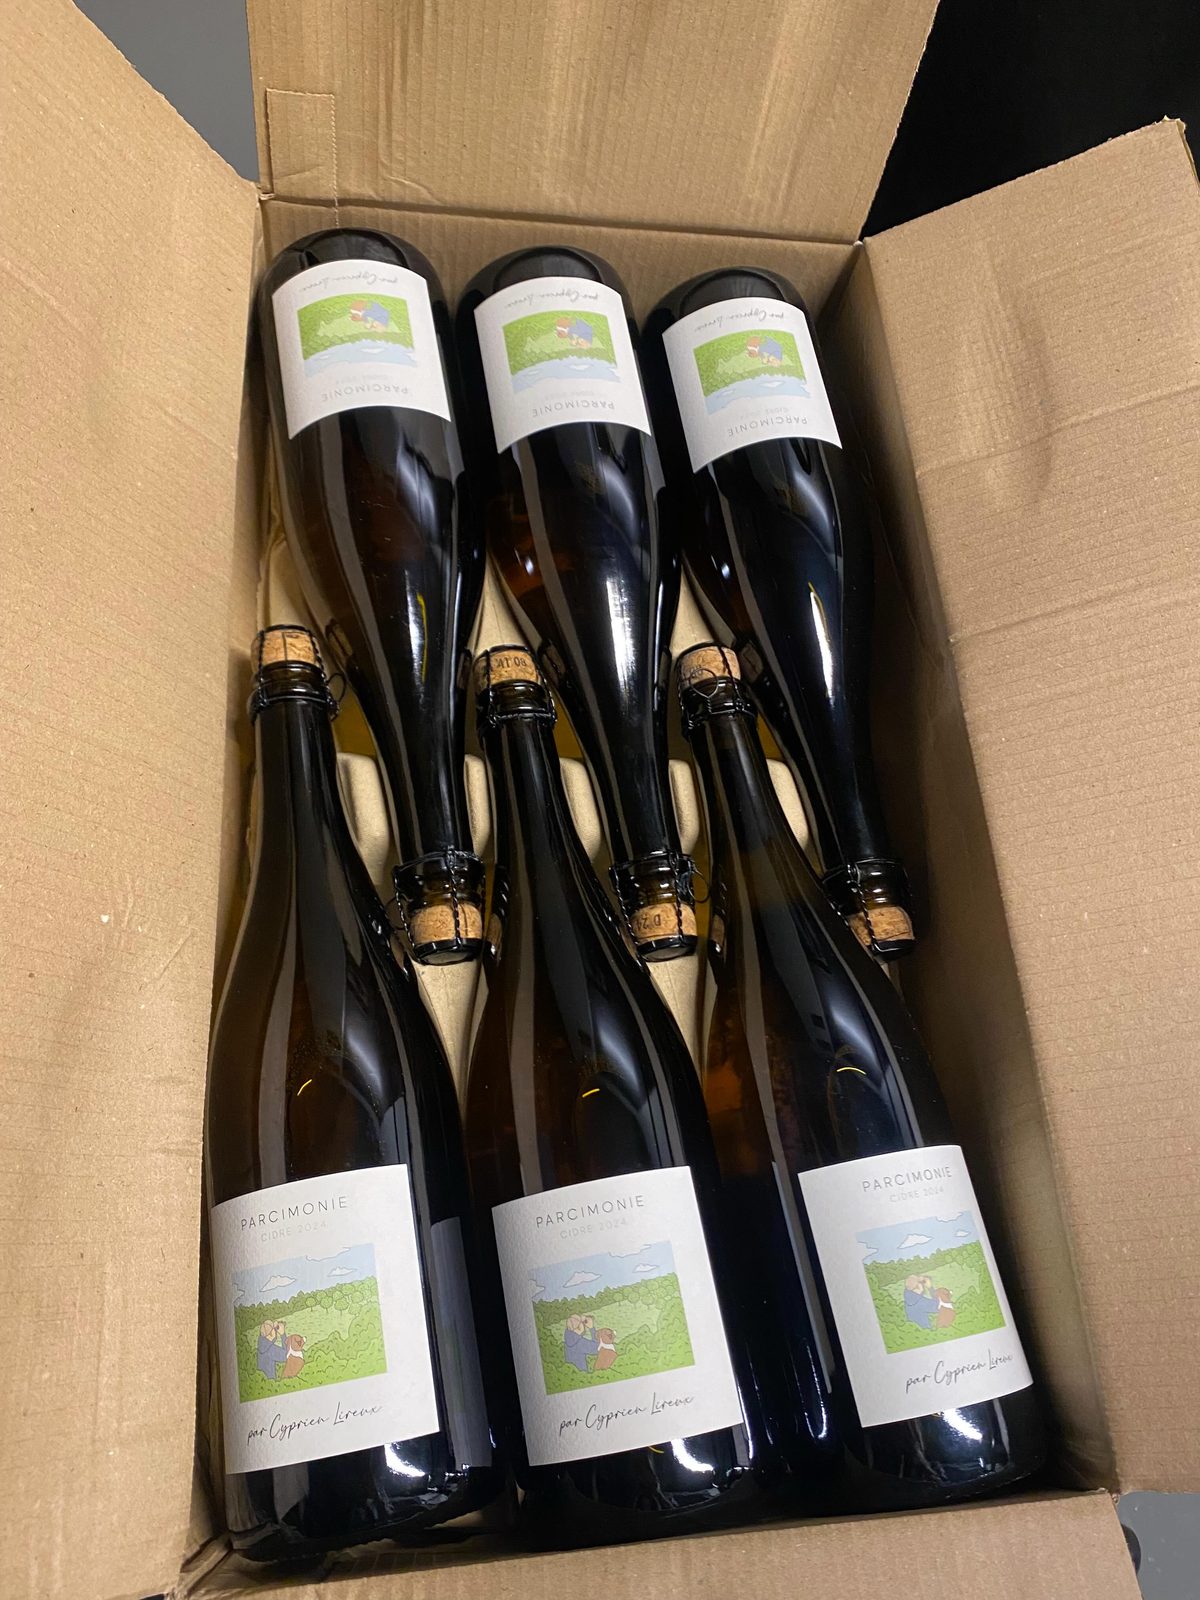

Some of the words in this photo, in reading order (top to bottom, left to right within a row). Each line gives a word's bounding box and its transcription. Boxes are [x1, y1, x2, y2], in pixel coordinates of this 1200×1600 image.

[321, 383, 409, 402] PARCIMONIE
[532, 399, 616, 418] PARCIMONIE
[727, 416, 808, 438] PARCIMONIE
[862, 1166, 954, 1193] PARCIMONIE
[889, 1189, 920, 1203] CIDRE
[240, 1195, 349, 1231] PARCIMONIE
[535, 1194, 645, 1229] PARCIMONIE
[260, 1226, 292, 1242] CIDRE
[294, 1220, 328, 1236] 2024
[559, 1224, 593, 1240] CIDRE
[598, 1217, 629, 1233] 2024
[905, 1373, 931, 1394] par
[932, 1360, 986, 1386] Cyprien
[247, 1425, 268, 1446] par
[268, 1413, 330, 1440] Cyprien
[558, 1416, 582, 1436] par
[584, 1403, 647, 1430] Cyprien
